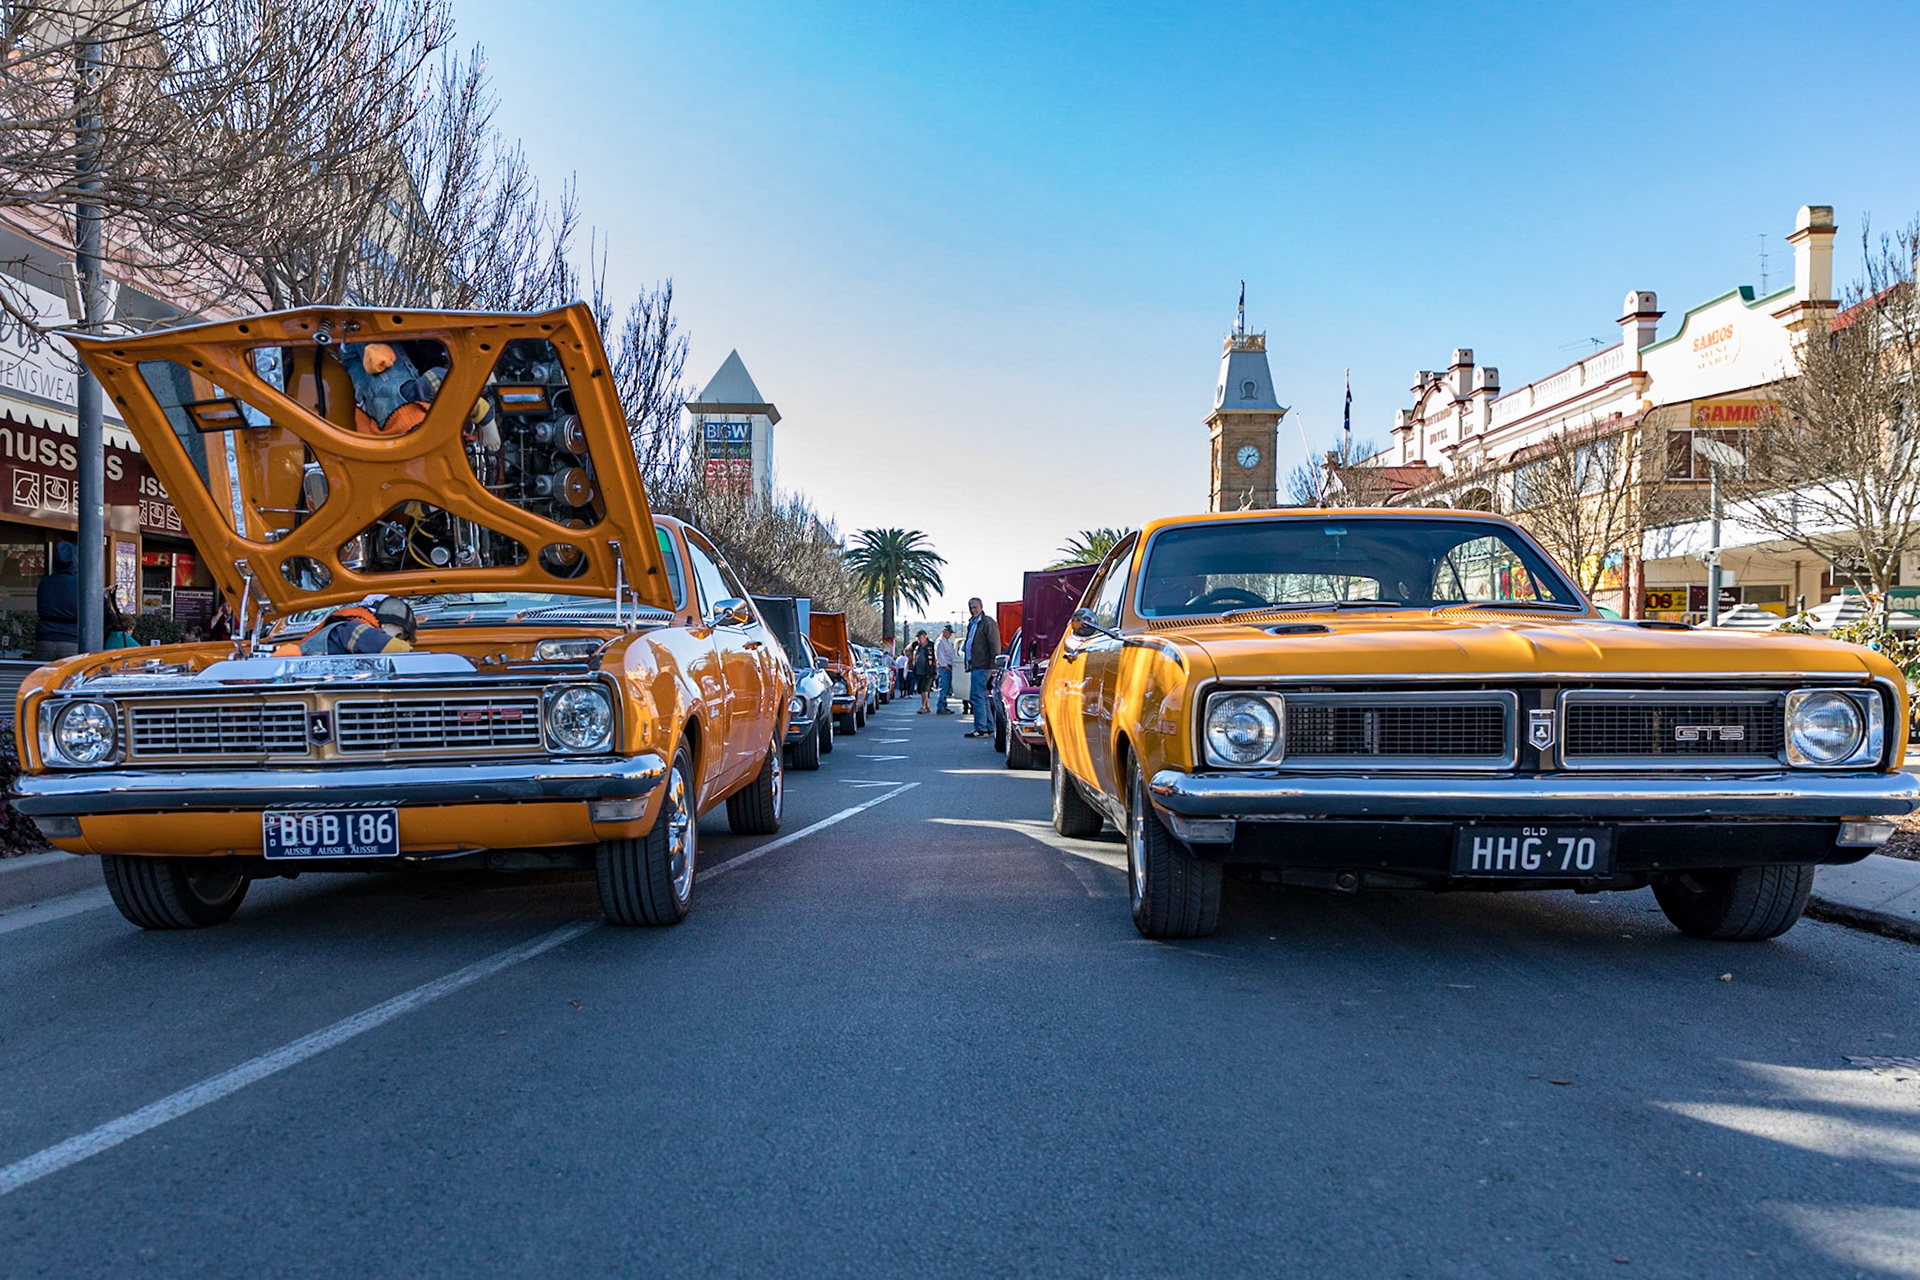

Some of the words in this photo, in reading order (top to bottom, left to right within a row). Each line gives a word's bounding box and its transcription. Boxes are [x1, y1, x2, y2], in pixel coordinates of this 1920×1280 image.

[1693, 323, 1733, 352] SAMIOS
[0, 357, 75, 404] ENSWEA
[460, 707, 523, 722] GTS
[1675, 726, 1744, 740] GTS
[1522, 827, 1548, 836] QLD
[284, 847, 312, 856] AUSSIE
[317, 847, 345, 855] AUSSIE
[351, 845, 379, 854] AUSSIE
